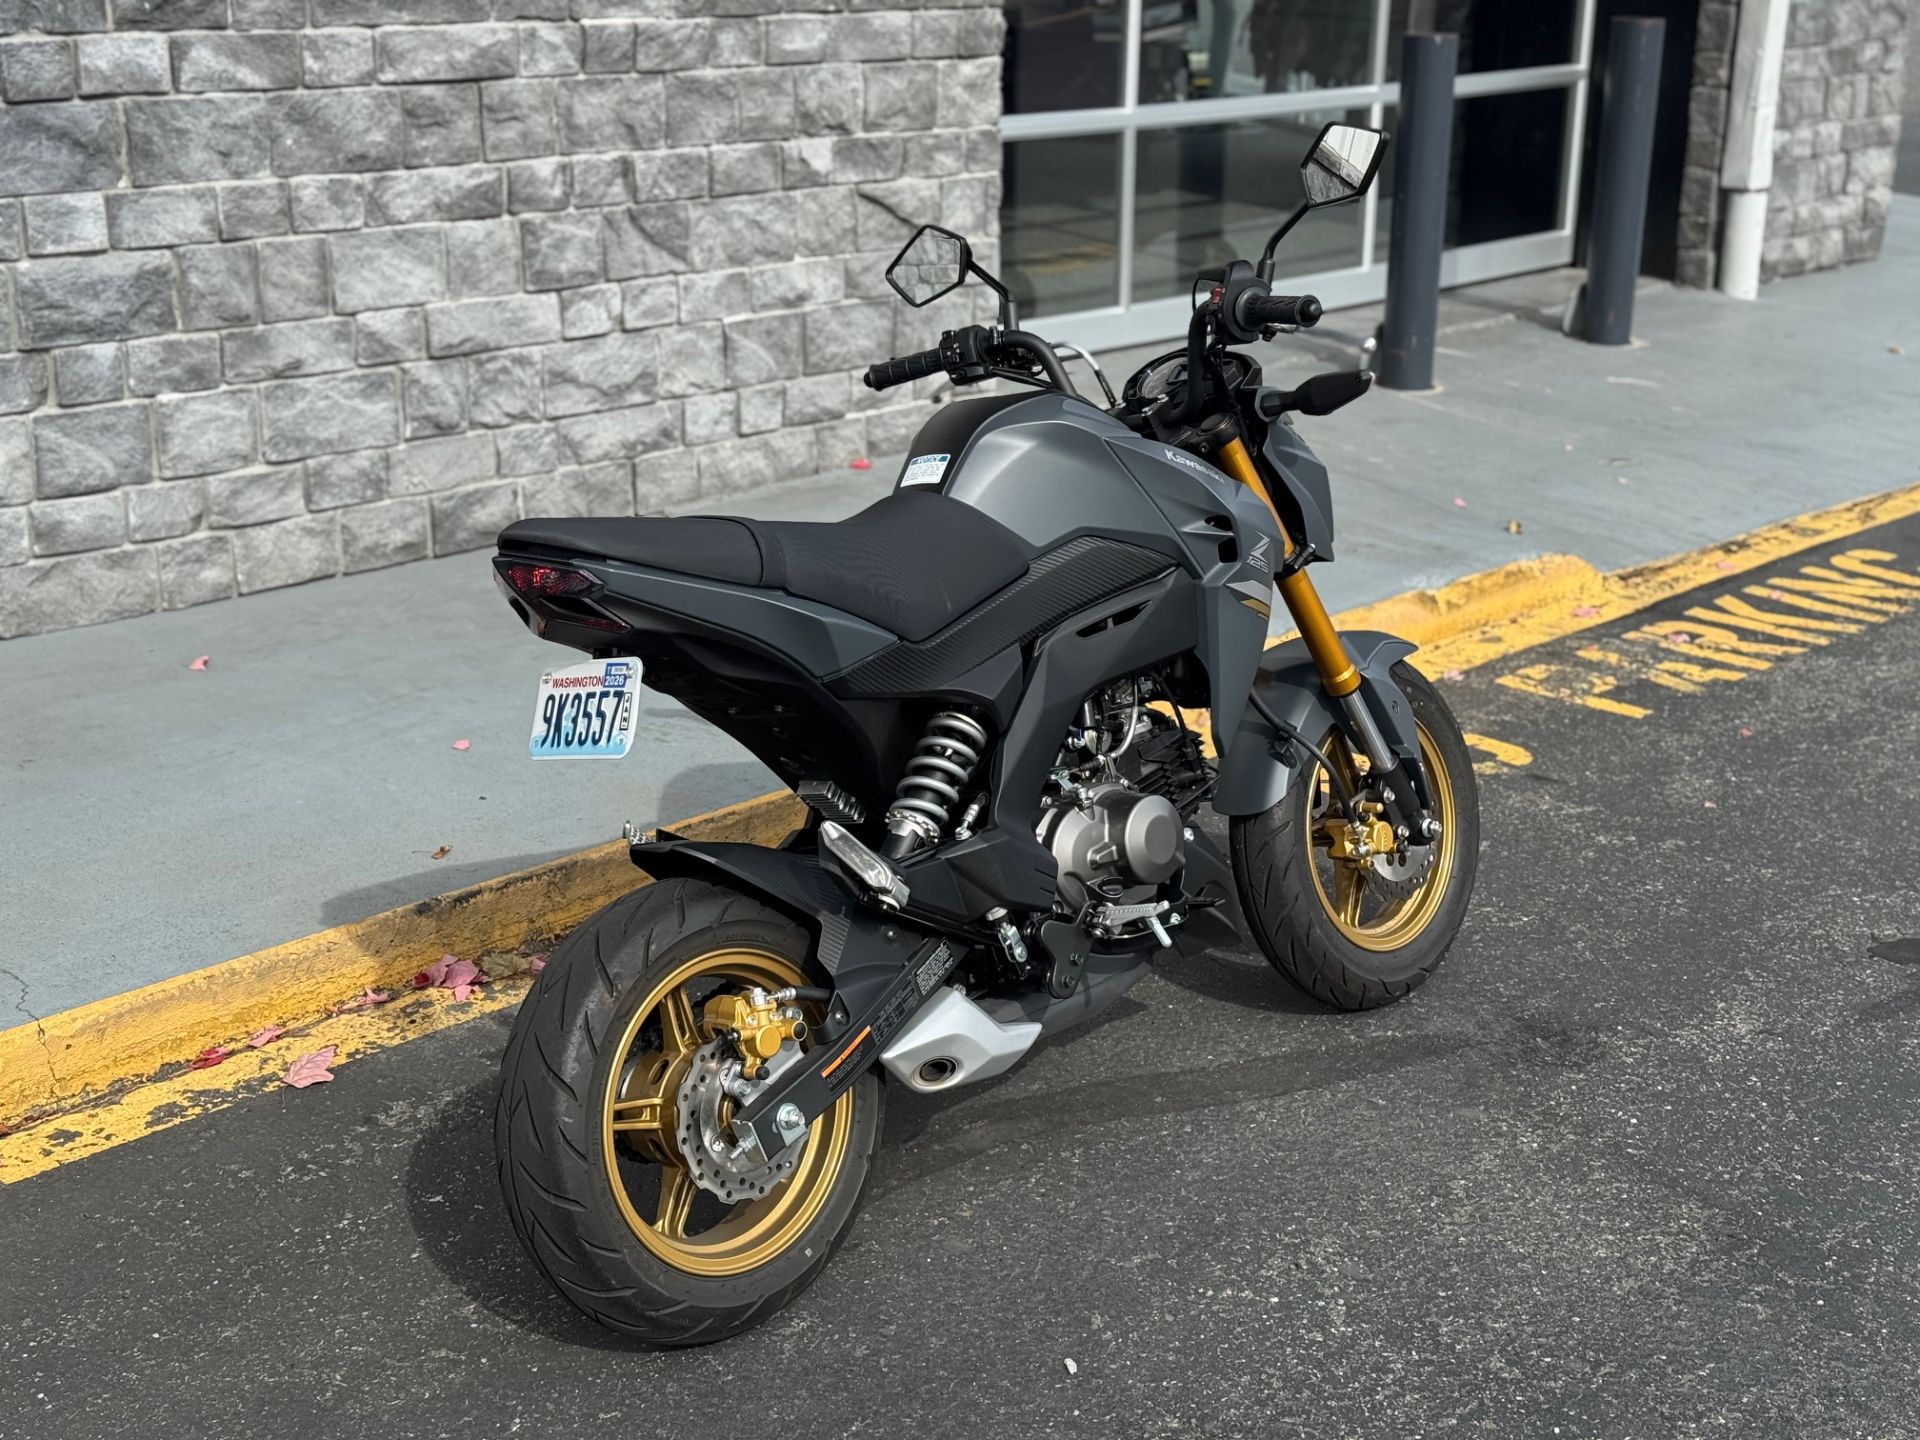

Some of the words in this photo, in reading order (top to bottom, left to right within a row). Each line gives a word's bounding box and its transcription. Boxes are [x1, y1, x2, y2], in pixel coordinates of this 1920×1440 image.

[552, 675, 603, 689] WASHINGTON
[604, 675, 625, 686] 2026
[540, 690, 625, 748] 9K3557
[622, 695, 630, 723] JAN
